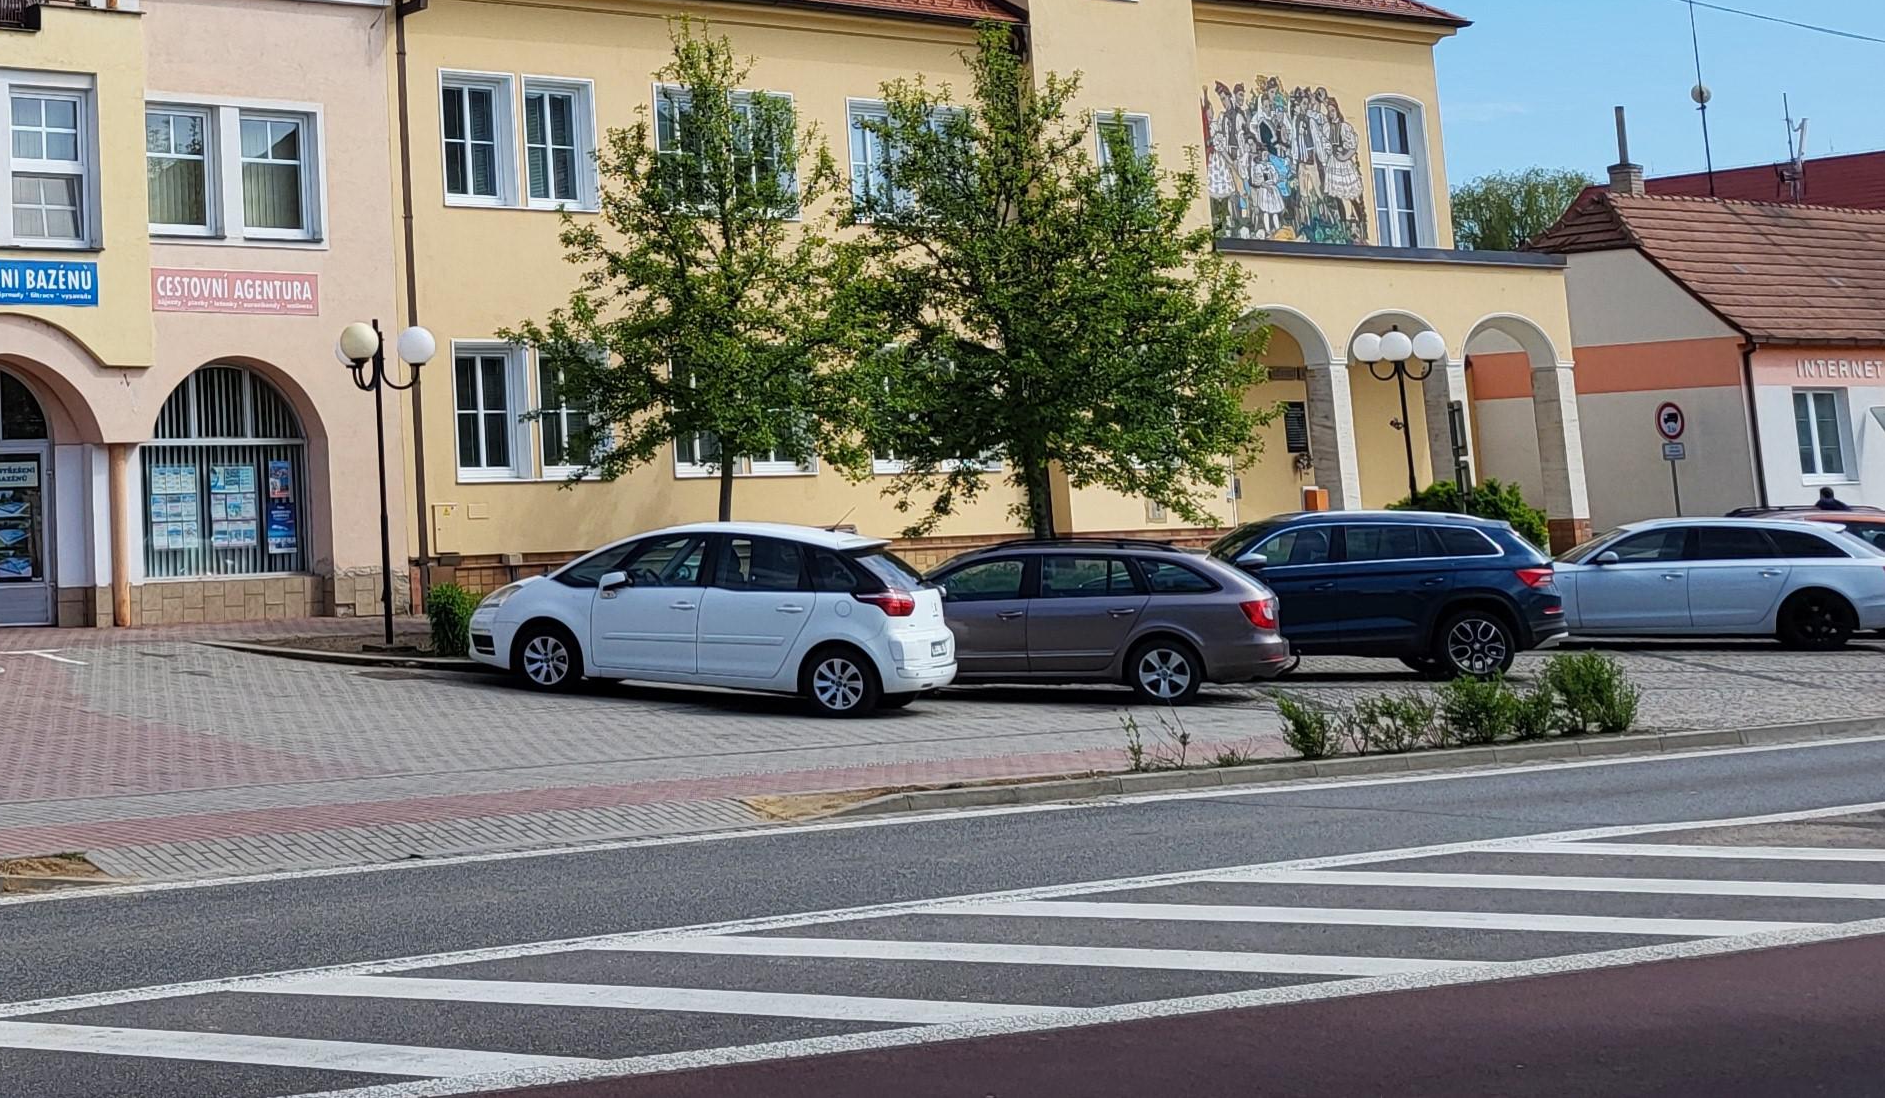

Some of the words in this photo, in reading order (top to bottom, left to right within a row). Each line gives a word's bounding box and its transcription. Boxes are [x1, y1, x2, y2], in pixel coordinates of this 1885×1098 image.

[156, 272, 228, 299] CESTOVNÍ
[233, 278, 313, 301] AGENTURA
[1796, 358, 1884, 379] INTERNET
